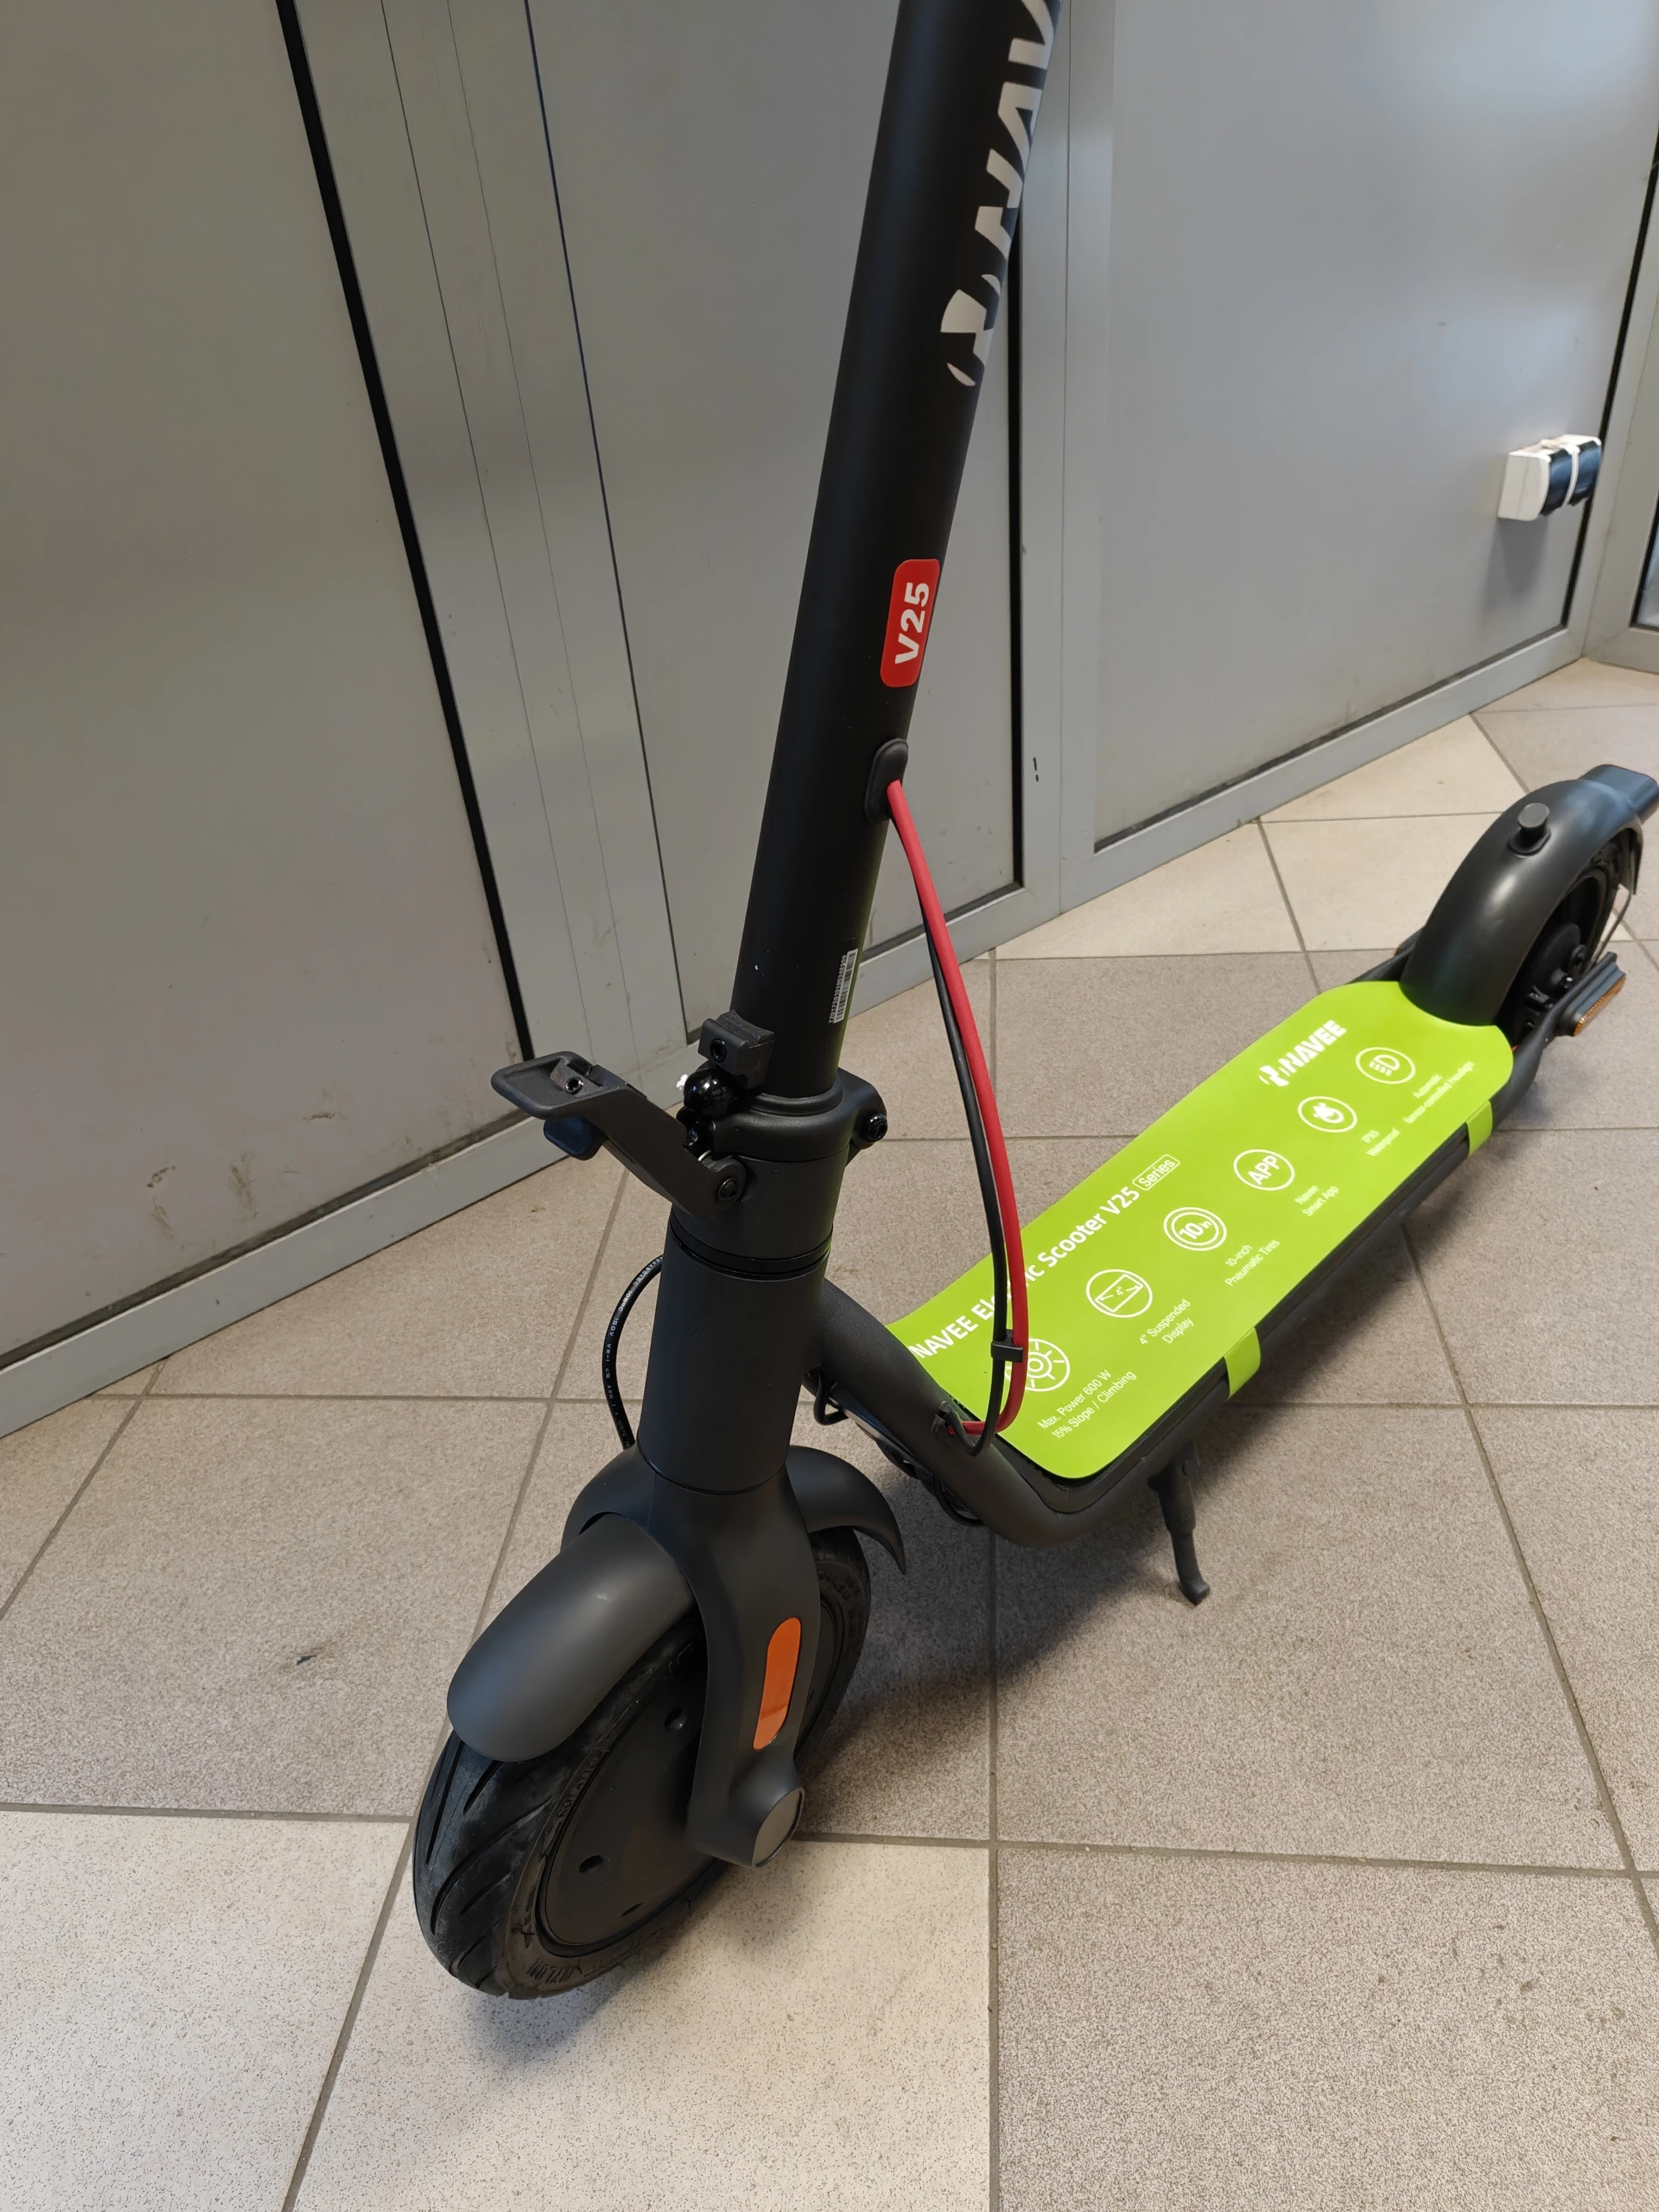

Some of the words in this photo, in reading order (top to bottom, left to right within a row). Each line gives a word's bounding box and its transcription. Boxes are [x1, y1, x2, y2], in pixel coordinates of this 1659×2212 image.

[895, 582, 929, 664] V25
[1278, 1020, 1347, 1074] NAVEE
[1247, 1155, 1280, 1185] APP
[908, 1315, 979, 1359] NAVEE
[1037, 1213, 1107, 1267] Scooter
[1099, 1186, 1139, 1215] V25
[1138, 1159, 1176, 1187] Series
[1225, 1245, 1252, 1267] 10-inch
[1258, 1239, 1280, 1256] Tires
[1147, 1298, 1191, 1337] Suspended
[1162, 1318, 1194, 1344] Display
[1037, 1415, 1062, 1429] Max.
[1056, 1393, 1085, 1416] Power
[1083, 1379, 1102, 1395] 600
[1097, 1369, 1111, 1380] W
[1051, 1425, 1073, 1438] 15%
[1068, 1407, 1095, 1427] Slope
[1092, 1399, 1100, 1410] /
[1097, 1371, 1137, 1402] Climbing
